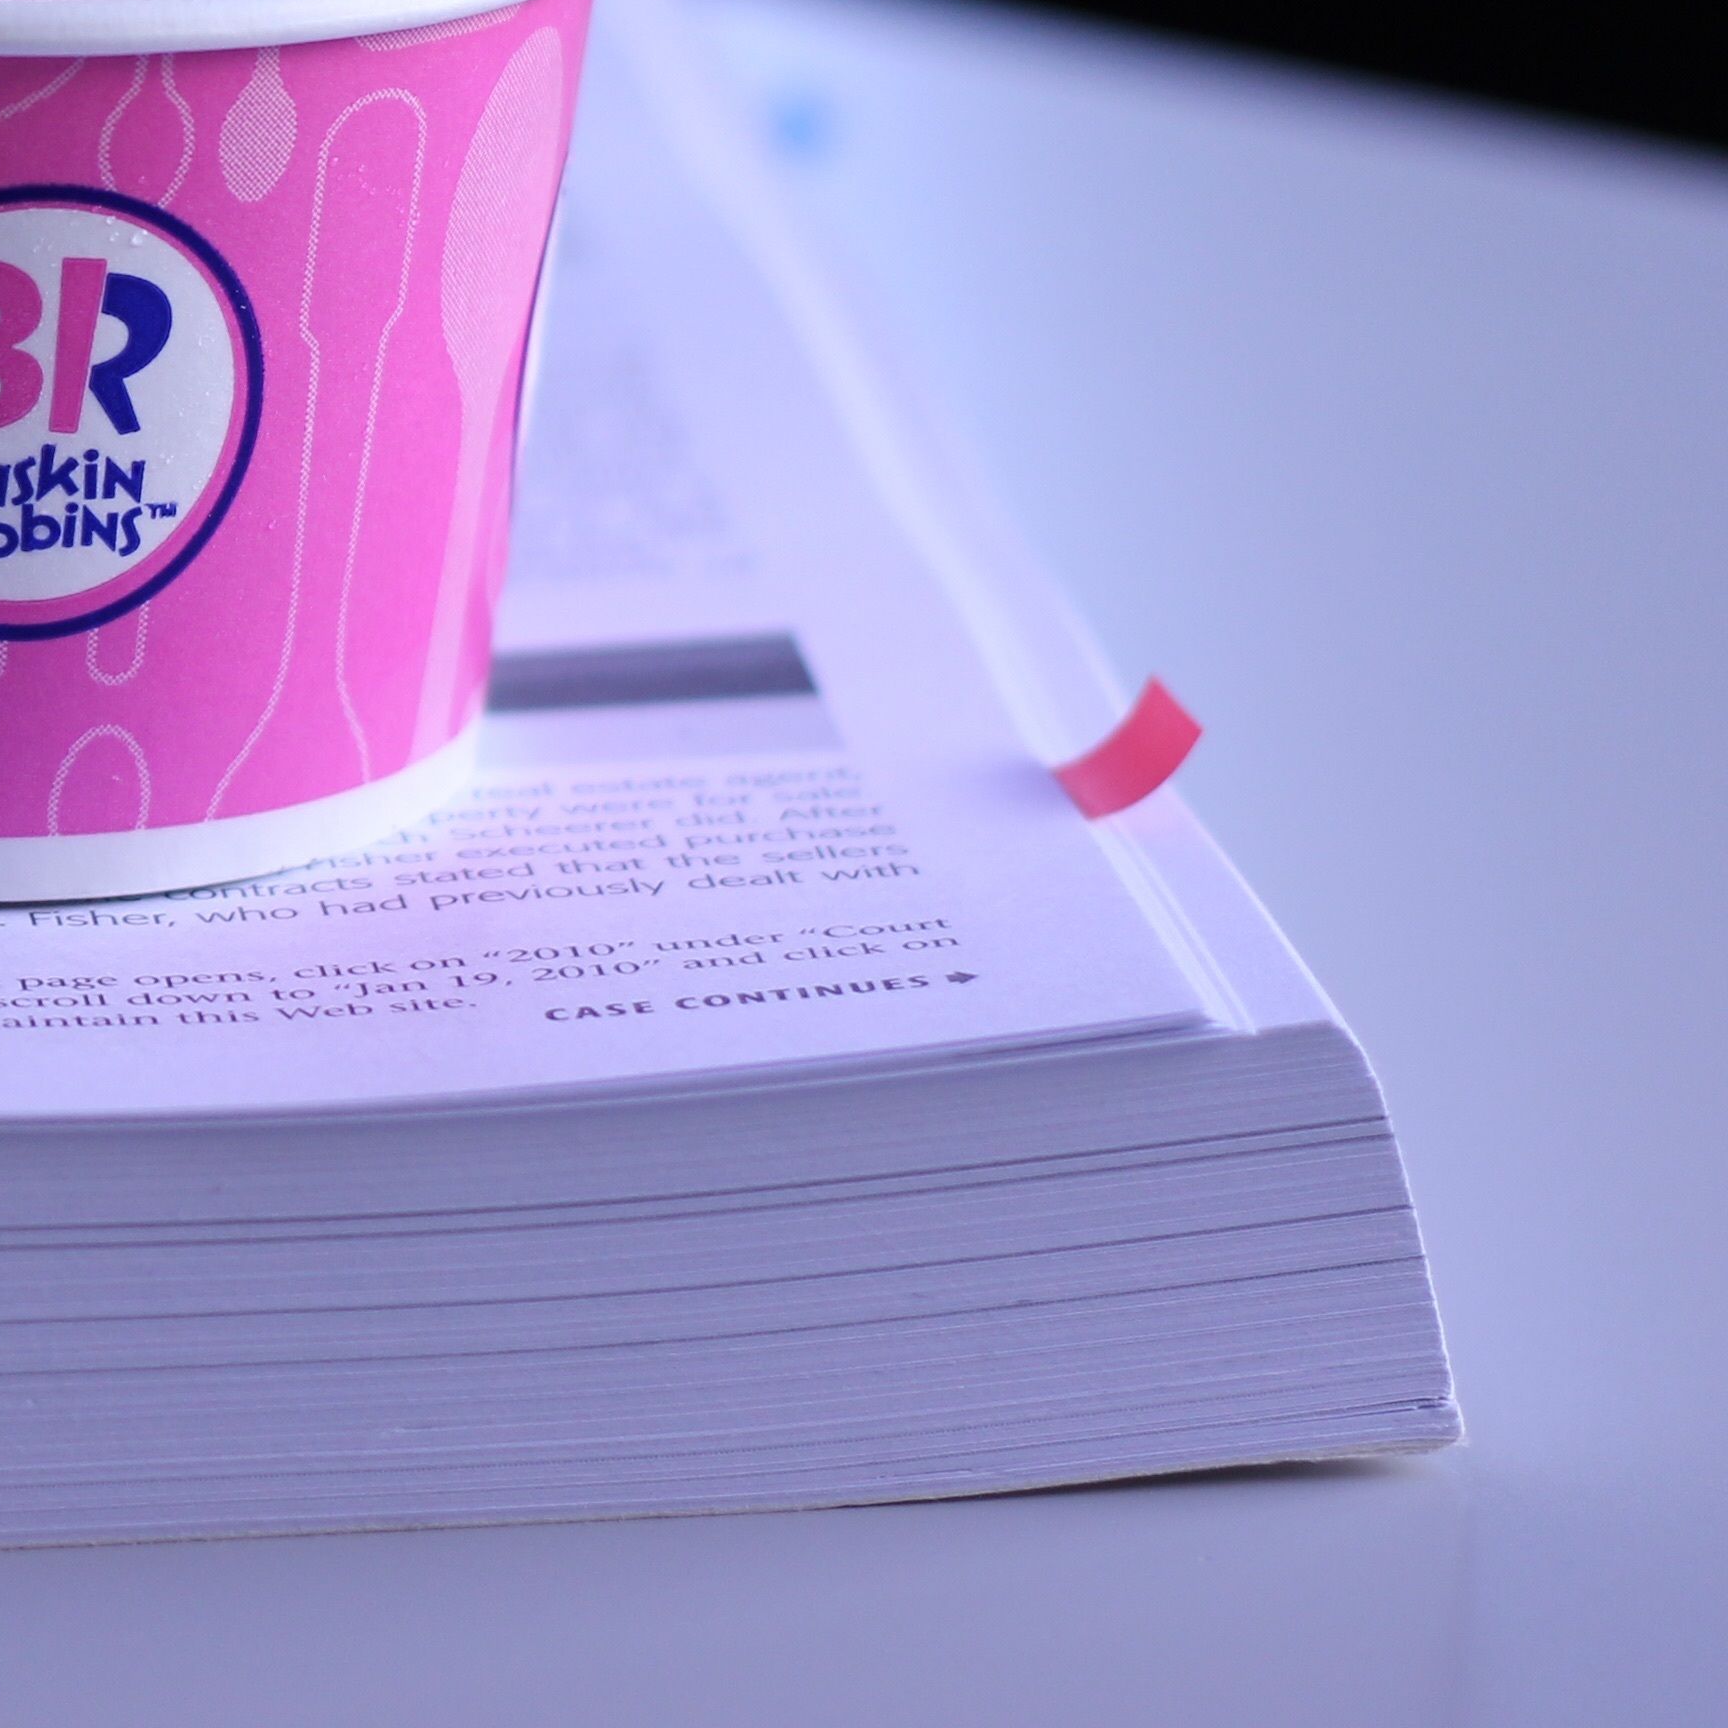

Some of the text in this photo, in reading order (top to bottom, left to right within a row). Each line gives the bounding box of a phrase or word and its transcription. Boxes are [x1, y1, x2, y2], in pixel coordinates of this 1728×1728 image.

[449, 818, 654, 841] Scheerer
[779, 804, 882, 822] After
[455, 833, 667, 860] executed
[684, 824, 897, 850] purchase
[394, 861, 536, 886] stated
[556, 856, 646, 875] that
[665, 852, 742, 869] the
[761, 844, 910, 862] sellers
[27, 908, 176, 929] Fisher,
[193, 904, 300, 924] who
[318, 892, 408, 918] had
[428, 876, 666, 912] previously
[686, 867, 807, 891] dealt
[819, 861, 923, 882] with
[17, 974, 120, 992] page
[133, 969, 277, 989] opens,
[293, 960, 397, 980] click
[409, 955, 467, 971] on
[482, 940, 636, 963] “2010”
[654, 932, 785, 953] under
[798, 917, 953, 939] “Court
[126, 990, 252, 1008] down
[272, 988, 316, 1002] to
[333, 979, 428, 1000] “Jan
[449, 971, 513, 988] 19,
[531, 958, 660, 982] 2010”
[682, 950, 767, 971] and
[782, 941, 886, 962] click
[901, 935, 961, 952] on
[177, 1008, 261, 1025] this
[276, 1002, 374, 1021] Web
[388, 994, 479, 1014] site.
[544, 974, 931, 1022] CASE CONTINUES
